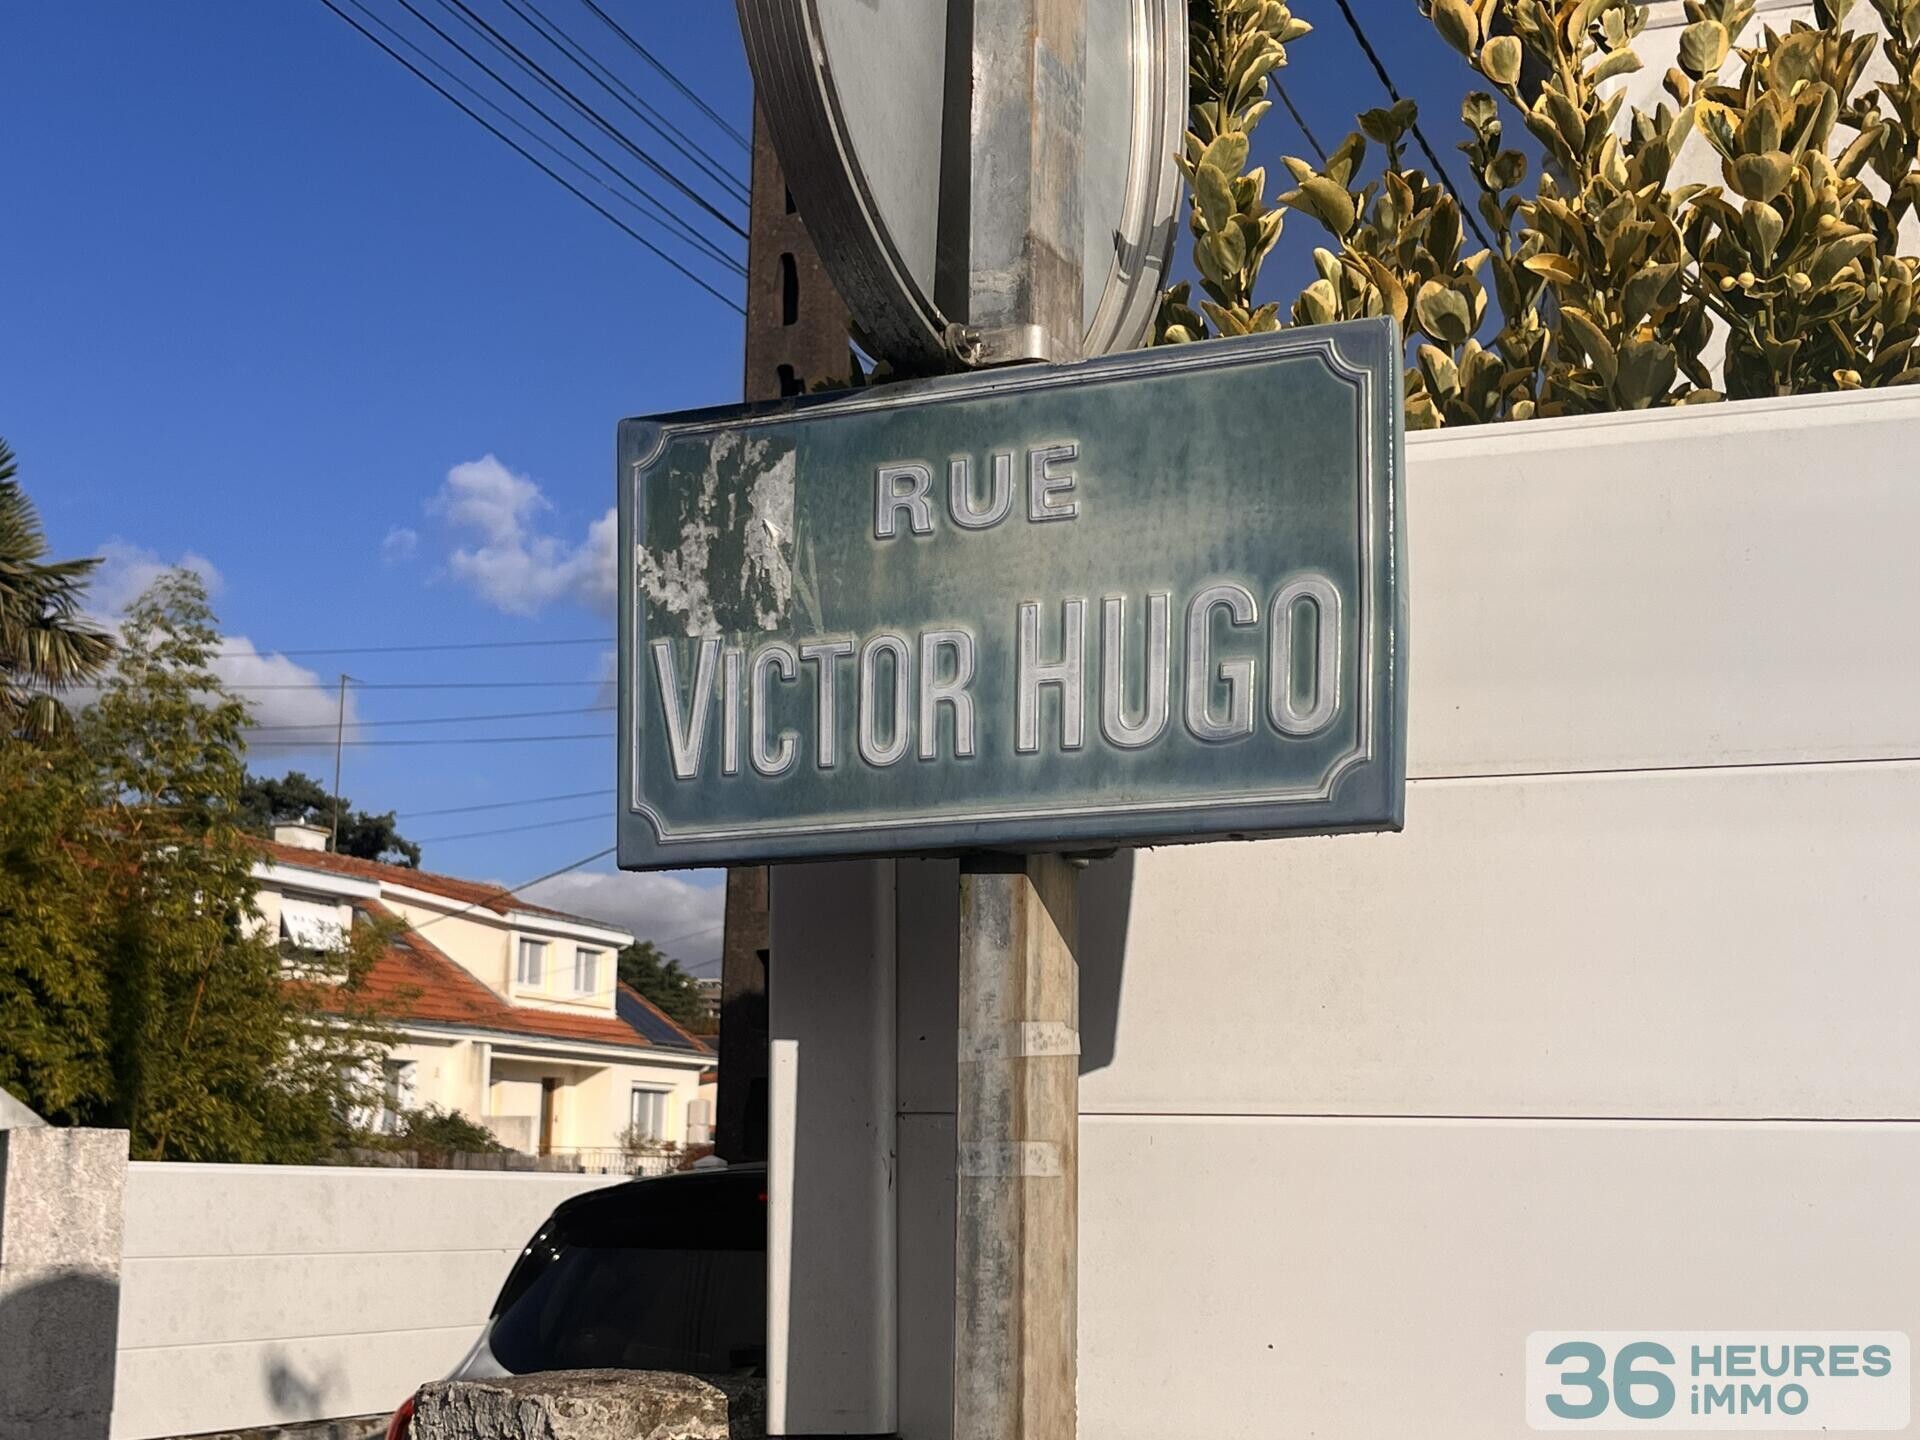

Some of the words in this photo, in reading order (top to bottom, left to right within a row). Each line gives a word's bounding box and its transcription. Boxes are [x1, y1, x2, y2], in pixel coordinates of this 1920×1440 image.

[874, 443, 1080, 538] RUE
[651, 628, 976, 779] VICTOR
[1016, 576, 1343, 753] HUGO
